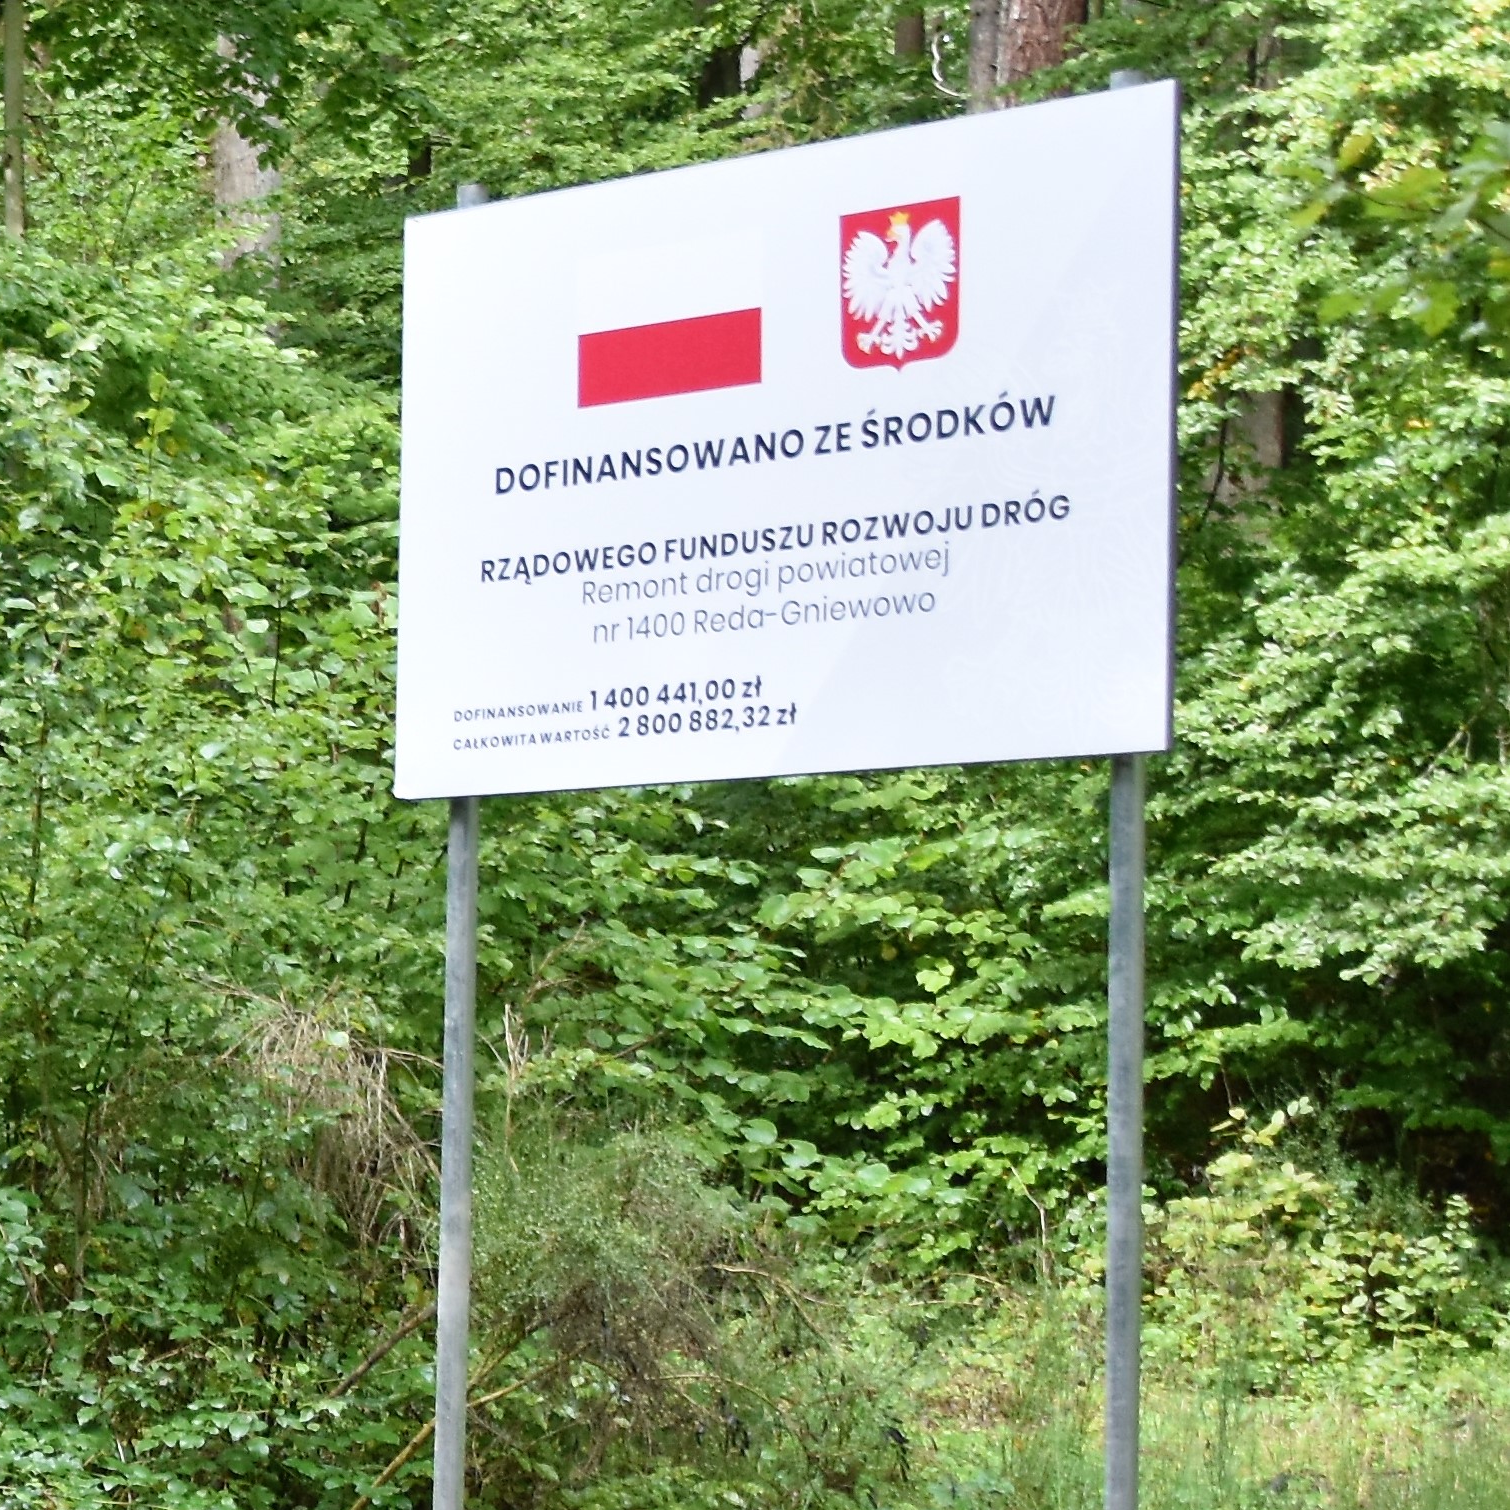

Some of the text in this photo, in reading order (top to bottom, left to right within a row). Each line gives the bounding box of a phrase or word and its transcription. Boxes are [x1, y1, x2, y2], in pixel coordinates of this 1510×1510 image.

[494, 391, 1057, 496] DOFINANSOWANO ZE ŚRODKÓW
[480, 488, 1071, 586] RZĄDOWEGO FUNDUSZU ROZWOJU DRÓG
[582, 541, 950, 605] Remont drogi powiatowej
[593, 591, 936, 644] nr 1400 Reda-Gniewowo
[452, 734, 537, 751] CAŁKOWITA
[539, 725, 611, 745] WARTOŚĆ
[635, 712, 683, 737] 800
[688, 704, 771, 734] 882,32
[775, 701, 798, 726] zł
[453, 700, 583, 723] DOFINANSOWANIE
[603, 685, 650, 710] 400
[655, 678, 736, 707] 441,00
[741, 674, 763, 699] zł
